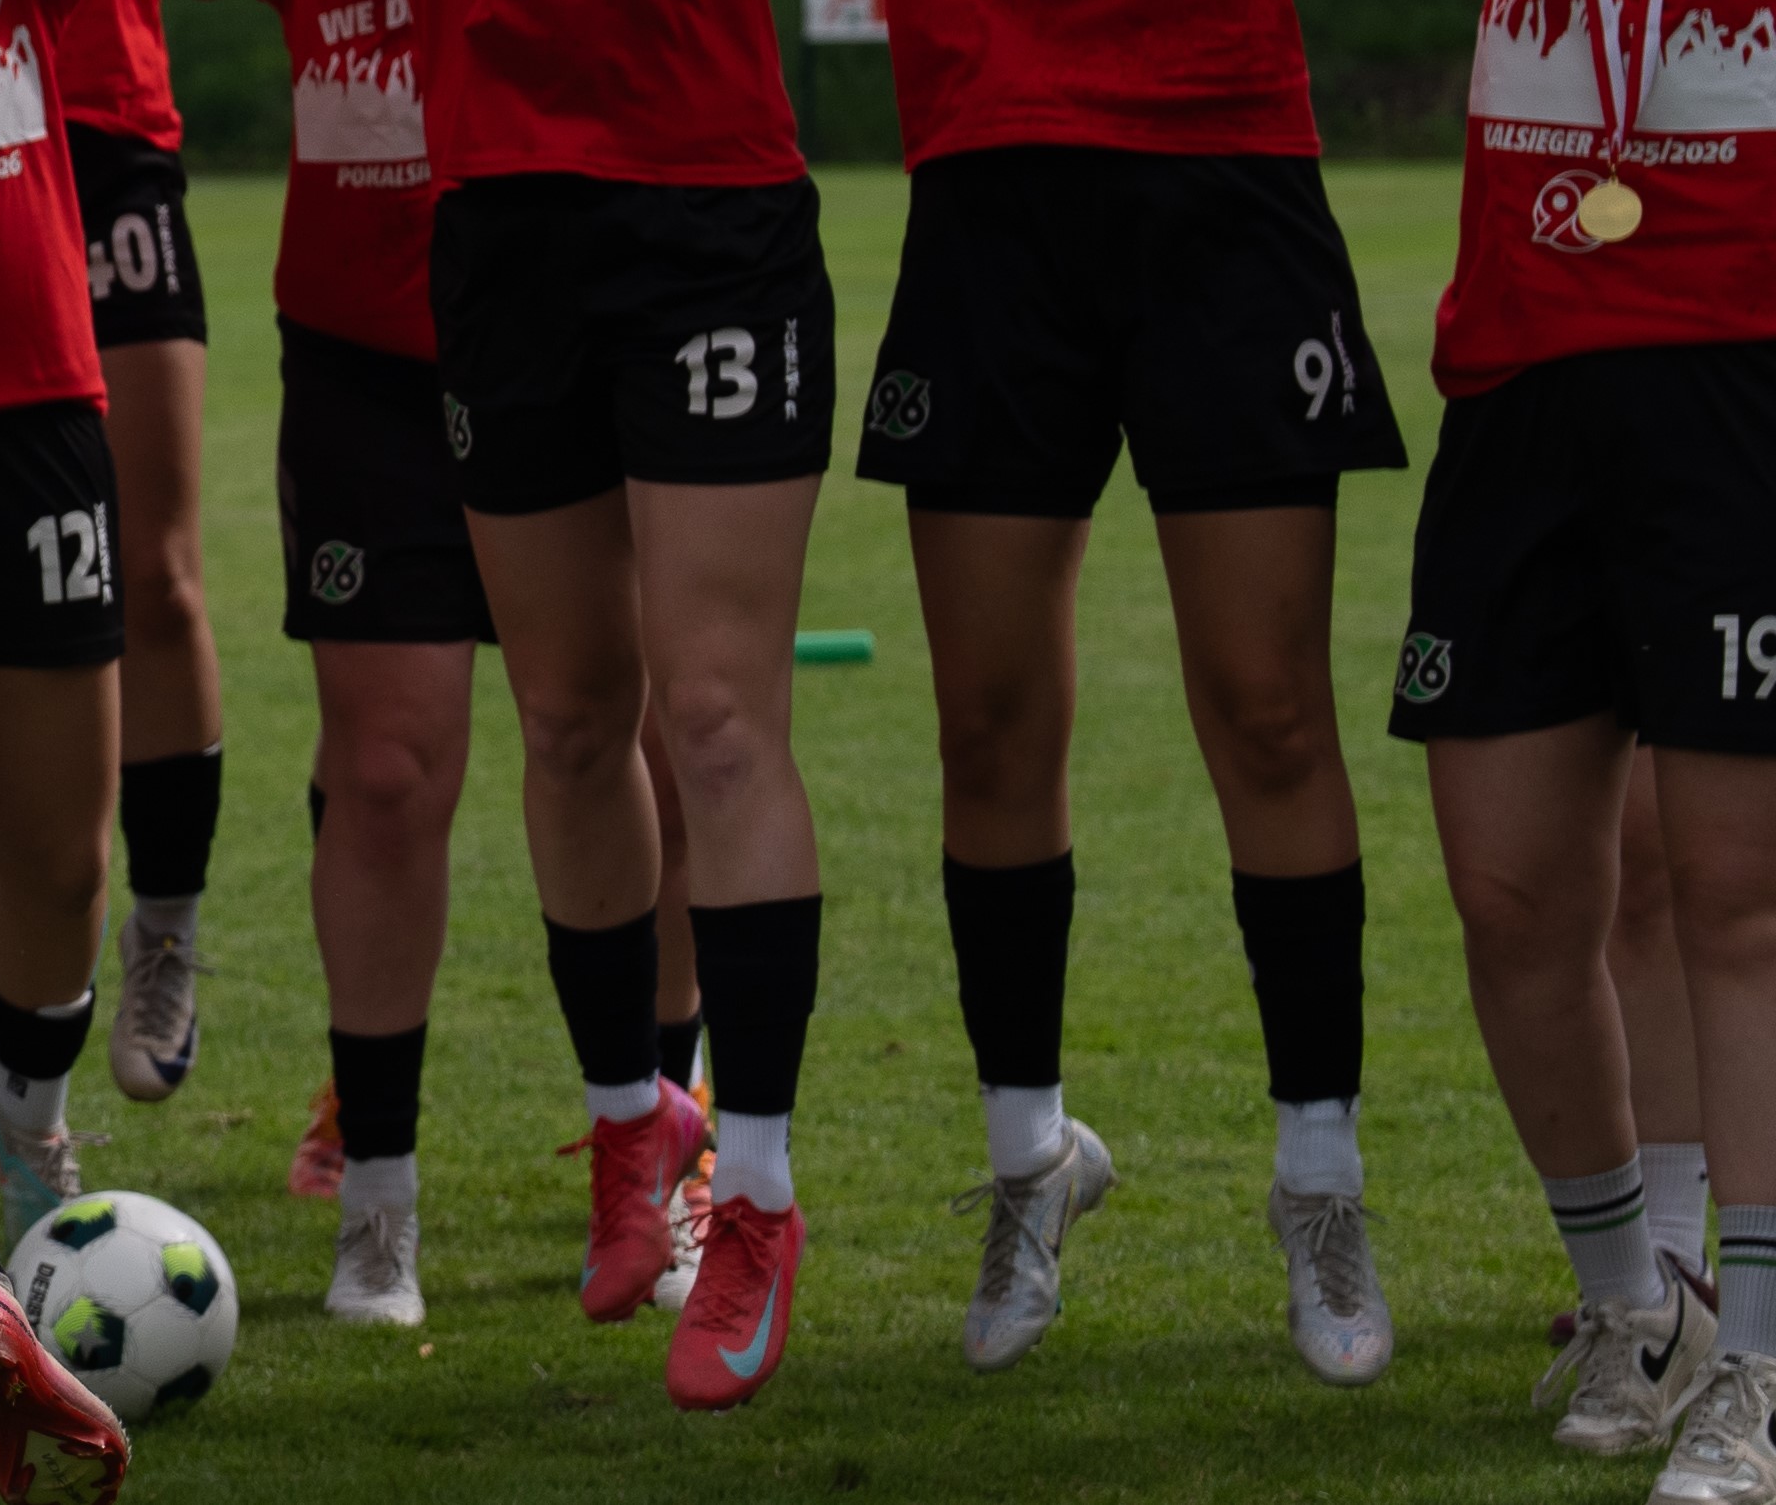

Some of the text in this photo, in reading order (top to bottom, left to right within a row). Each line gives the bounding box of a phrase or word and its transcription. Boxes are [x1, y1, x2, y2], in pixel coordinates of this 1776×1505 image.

[673, 326, 760, 421] 13
[868, 369, 932, 441] 96
[1293, 337, 1335, 422] 9
[25, 508, 102, 605] 12
[310, 539, 366, 607] 96
[1395, 631, 1455, 705] 96
[1711, 613, 1776, 702] 19
